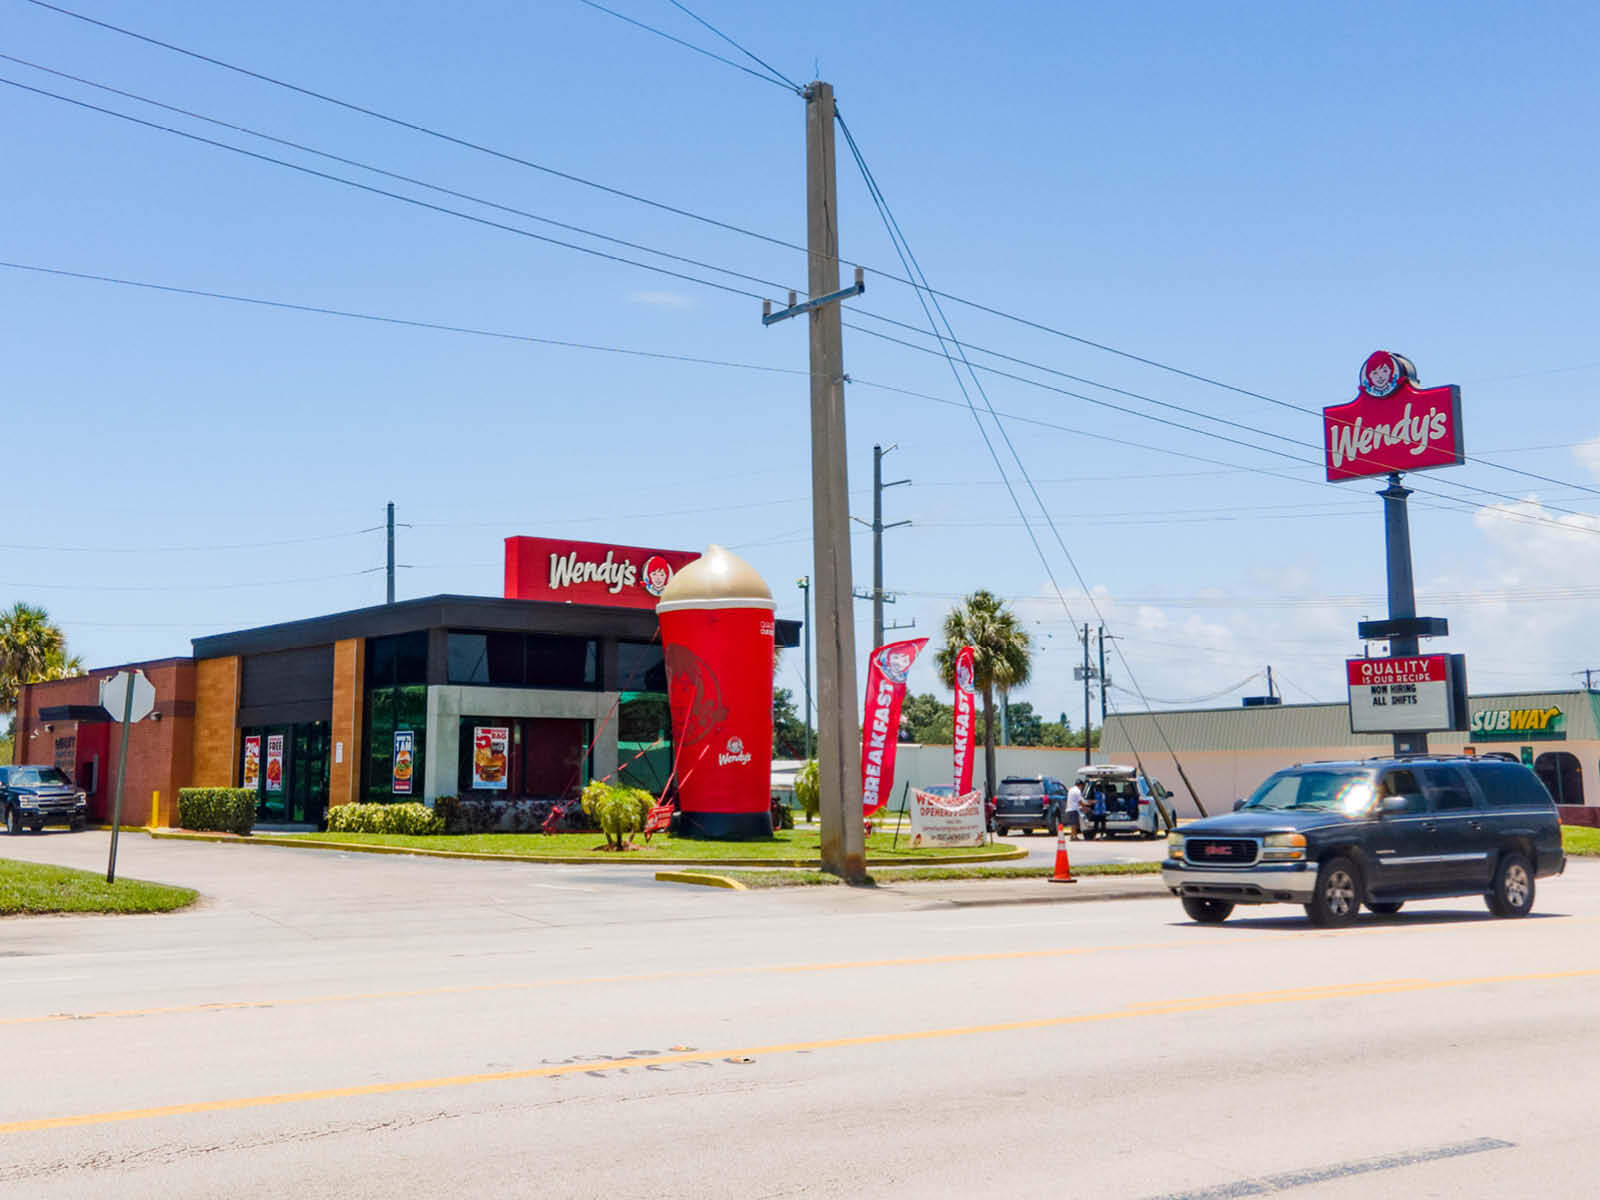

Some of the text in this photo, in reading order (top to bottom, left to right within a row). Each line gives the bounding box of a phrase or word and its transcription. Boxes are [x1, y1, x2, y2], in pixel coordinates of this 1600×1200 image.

[1330, 402, 1447, 468] Wendy's
[548, 550, 637, 594] Wendy's
[1361, 660, 1430, 676] QUALITY
[1362, 672, 1431, 684] IS OUR RECIPE
[1371, 683, 1417, 695] NOW HIRING
[1373, 695, 1418, 706] ALL SHIFTS
[1471, 704, 1561, 731] SUBWAY
[863, 679, 894, 806] BREAKFAST
[718, 750, 752, 766] Wendy's
